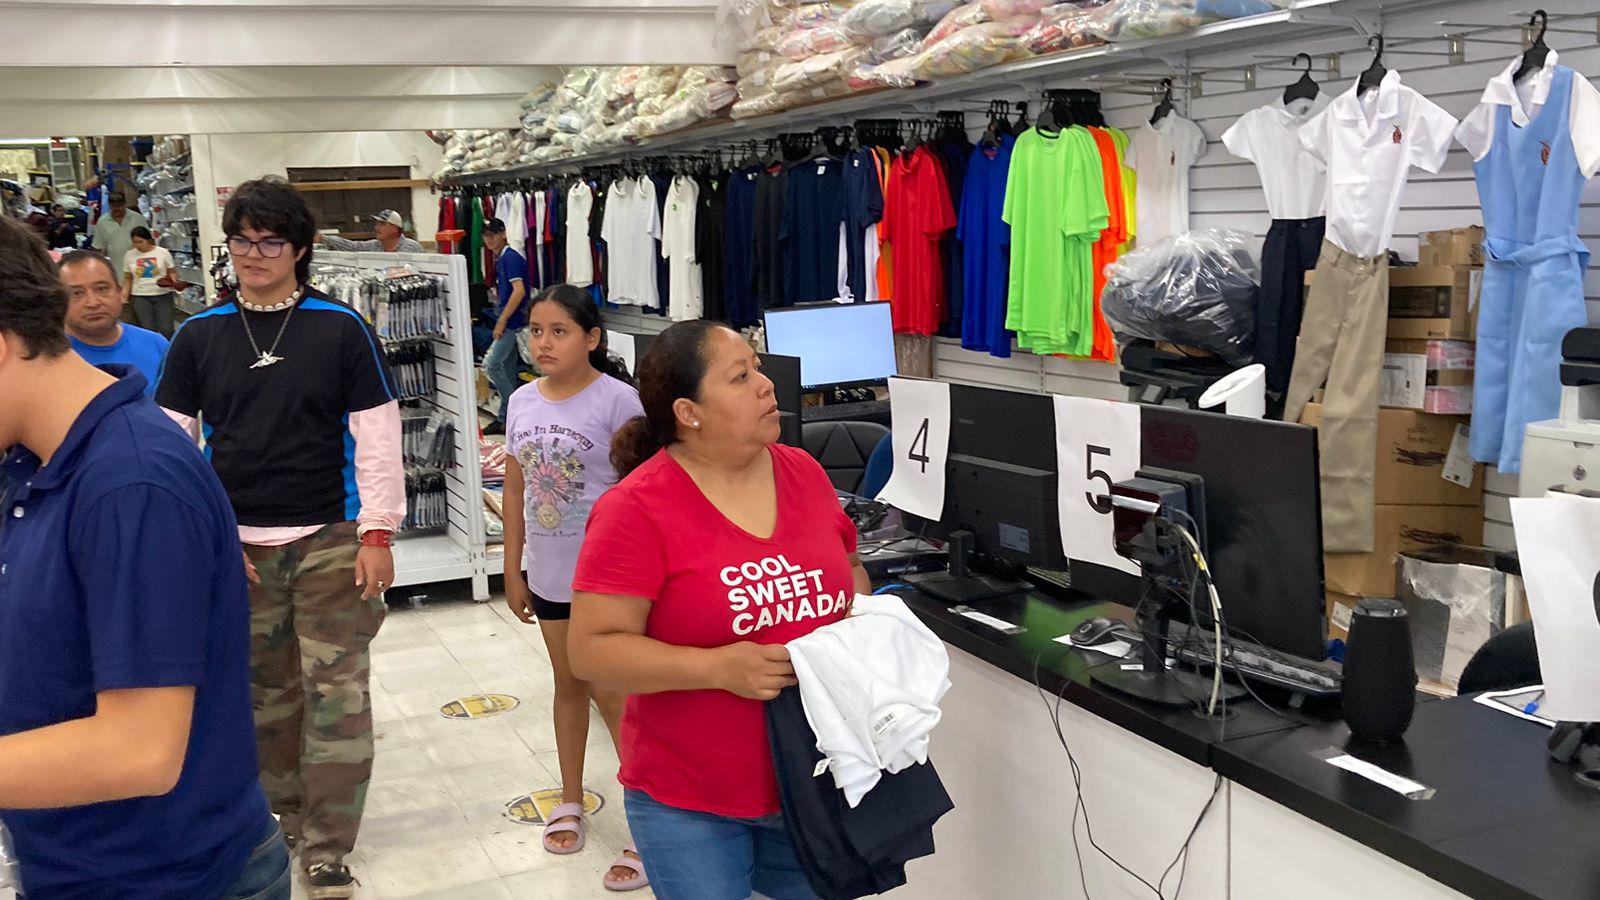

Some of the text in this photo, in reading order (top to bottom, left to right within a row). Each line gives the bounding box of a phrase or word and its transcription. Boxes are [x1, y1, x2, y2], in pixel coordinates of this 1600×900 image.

[908, 417, 930, 474] 4
[1085, 443, 1114, 515] 5
[720, 554, 802, 587] COOL
[727, 568, 824, 612] SWEET
